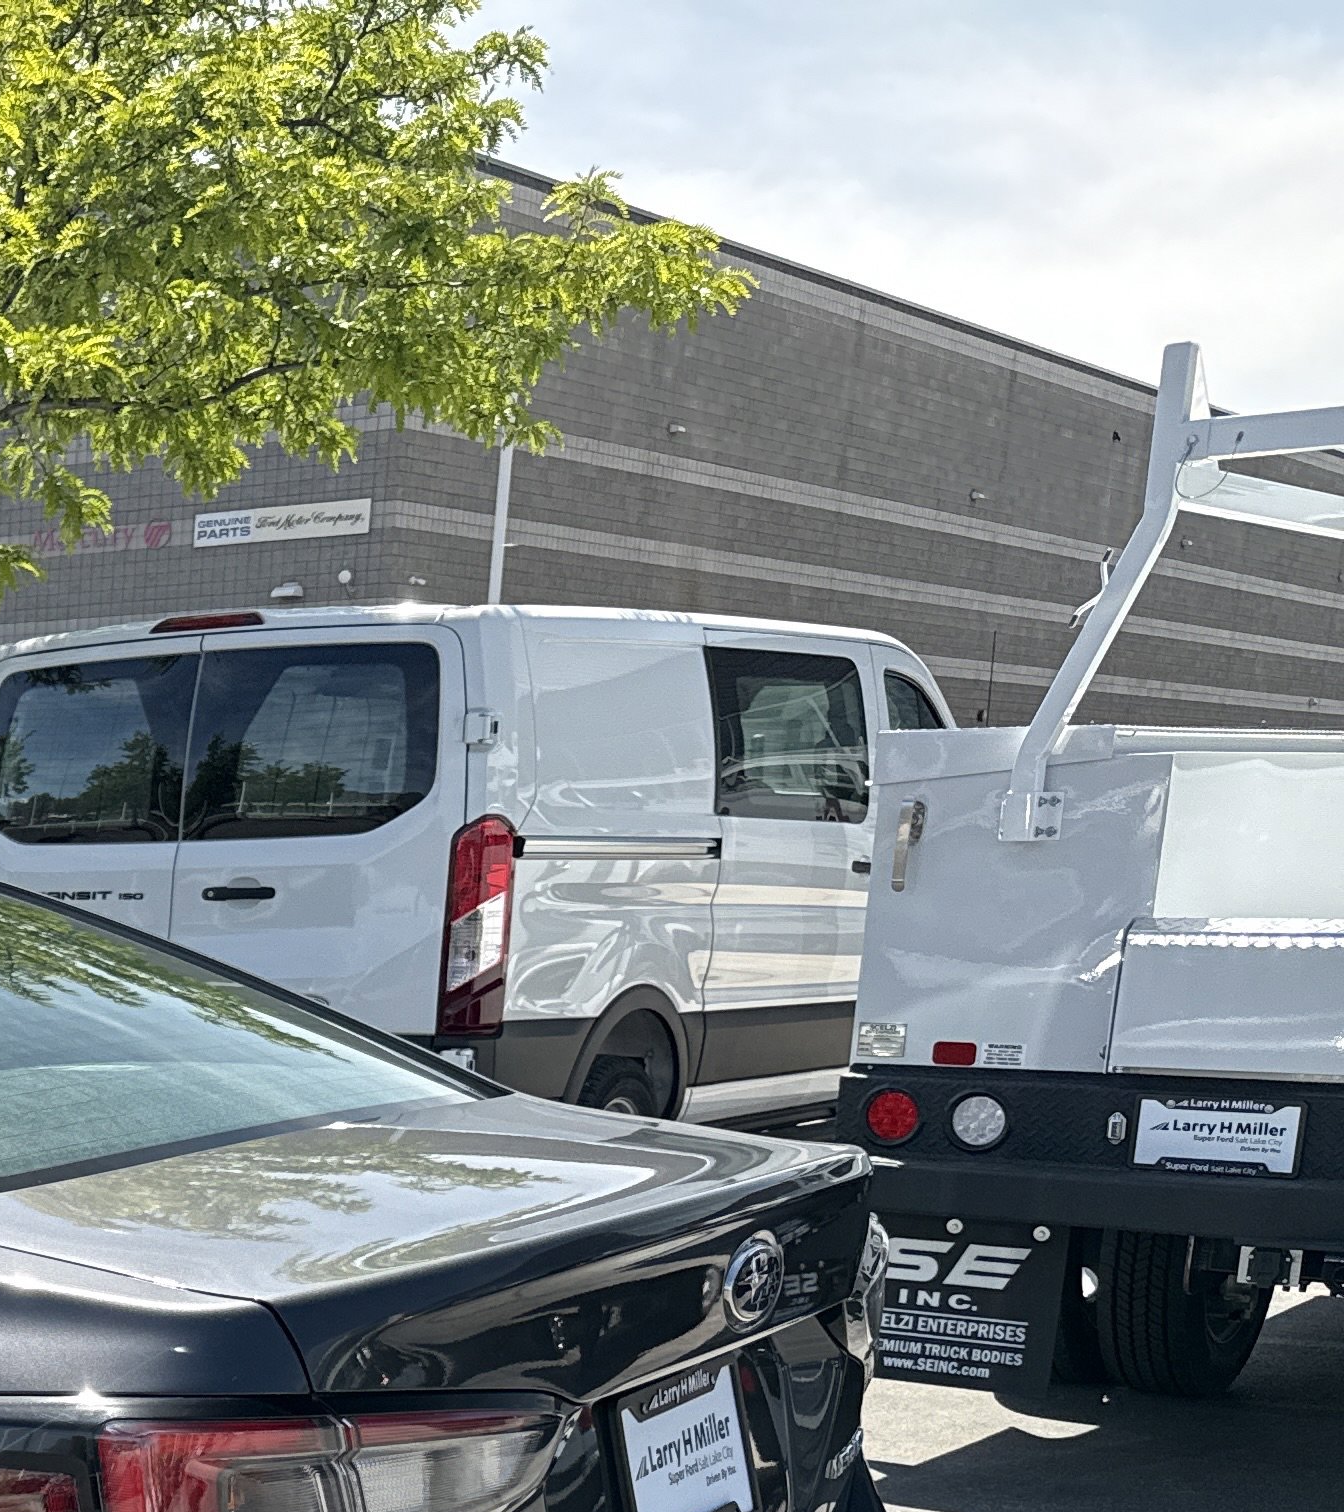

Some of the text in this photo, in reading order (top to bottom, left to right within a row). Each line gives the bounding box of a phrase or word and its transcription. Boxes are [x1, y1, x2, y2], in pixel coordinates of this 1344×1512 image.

[198, 516, 251, 528] GENUINE
[276, 514, 311, 531] Motor
[196, 526, 251, 540] PARTS
[1190, 1099, 1265, 1111] Larry H Miller
[1173, 1119, 1287, 1137] Larry H Miller
[1250, 1137, 1266, 1145] Lake
[1268, 1138, 1282, 1147] City
[1165, 1162, 1257, 1176] Super Ford Salt Lake City
[885, 1237, 1032, 1290] SE
[898, 1288, 977, 1311] INC.
[880, 1313, 1026, 1343] ELZI ENTERPRISES
[923, 1344, 969, 1360] TRUCK
[972, 1348, 1023, 1366] BODIES
[883, 1356, 990, 1378] www.SEINC.com
[658, 1368, 710, 1407] Larry H Miller
[647, 1412, 730, 1473] Larry H Miller
[668, 1445, 734, 1486] Super Ford Salt Lake City
[706, 1472, 721, 1487] Driven
